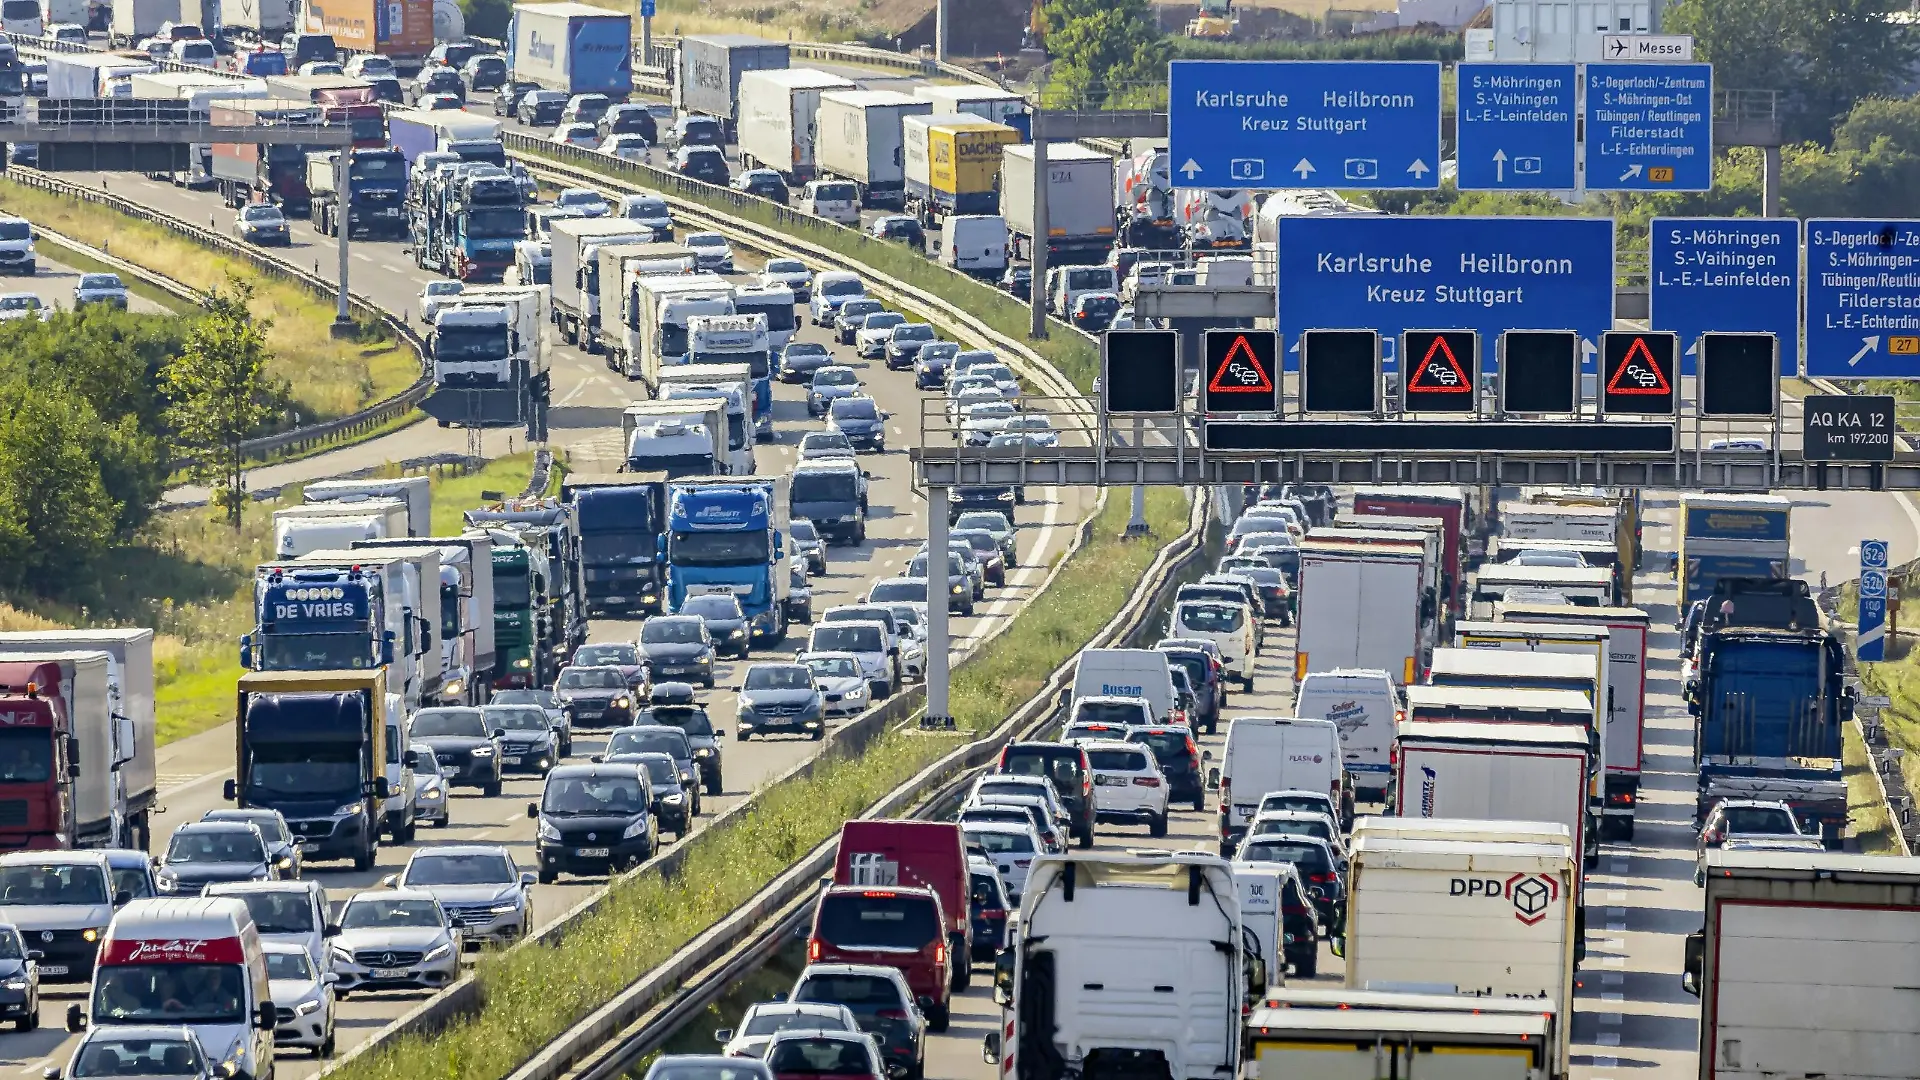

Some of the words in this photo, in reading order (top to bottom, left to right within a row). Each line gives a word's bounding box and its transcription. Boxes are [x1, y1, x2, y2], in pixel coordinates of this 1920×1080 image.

[1639, 42, 1682, 54] Messe
[1473, 76, 1562, 91] S.-Möhringen
[1591, 76, 1706, 91] S.-Degerloch/-Zentrum
[1196, 90, 1289, 107] Karlsruhe
[1323, 91, 1414, 107] Heilbronn
[1476, 93, 1558, 108] S.-Vaihingen
[1604, 93, 1693, 107] S.-Möhringen-Ost
[1465, 109, 1568, 122] L.-E.-Leinfelden
[1596, 110, 1639, 124] Tübingen
[1648, 110, 1701, 124] Reutlingen
[1242, 117, 1289, 131] Kreuz
[1296, 116, 1367, 134] Stuttgart
[1611, 126, 1685, 139] Filderstadt
[1601, 143, 1695, 158] L.-E.-Echterdingen
[1243, 162, 1252, 176] 8
[1356, 162, 1365, 175] 8
[1654, 170, 1667, 180] 27
[1670, 230, 1780, 248] S.-Möhringen
[1317, 253, 1432, 273] Karlsruhe
[1460, 253, 1572, 274] Heilbronn
[1675, 250, 1776, 269] S.-Vaihingen
[1659, 271, 1790, 286] L.-E.-Leinfelden
[1367, 285, 1425, 303] Kreuz
[1435, 285, 1523, 308] Stuttgart
[1826, 313, 1920, 331] L.-E.-Echterdin
[1896, 340, 1912, 351] 27
[1810, 412, 1833, 427] AQ
[1838, 412, 1862, 427] KA
[1870, 413, 1884, 427] 12
[1827, 433, 1845, 443] km
[1864, 548, 1884, 561] 52a
[276, 604, 298, 618] DE
[302, 603, 354, 617] VRIES
[1102, 684, 1142, 696] Busam
[1450, 879, 1502, 898] DPD
